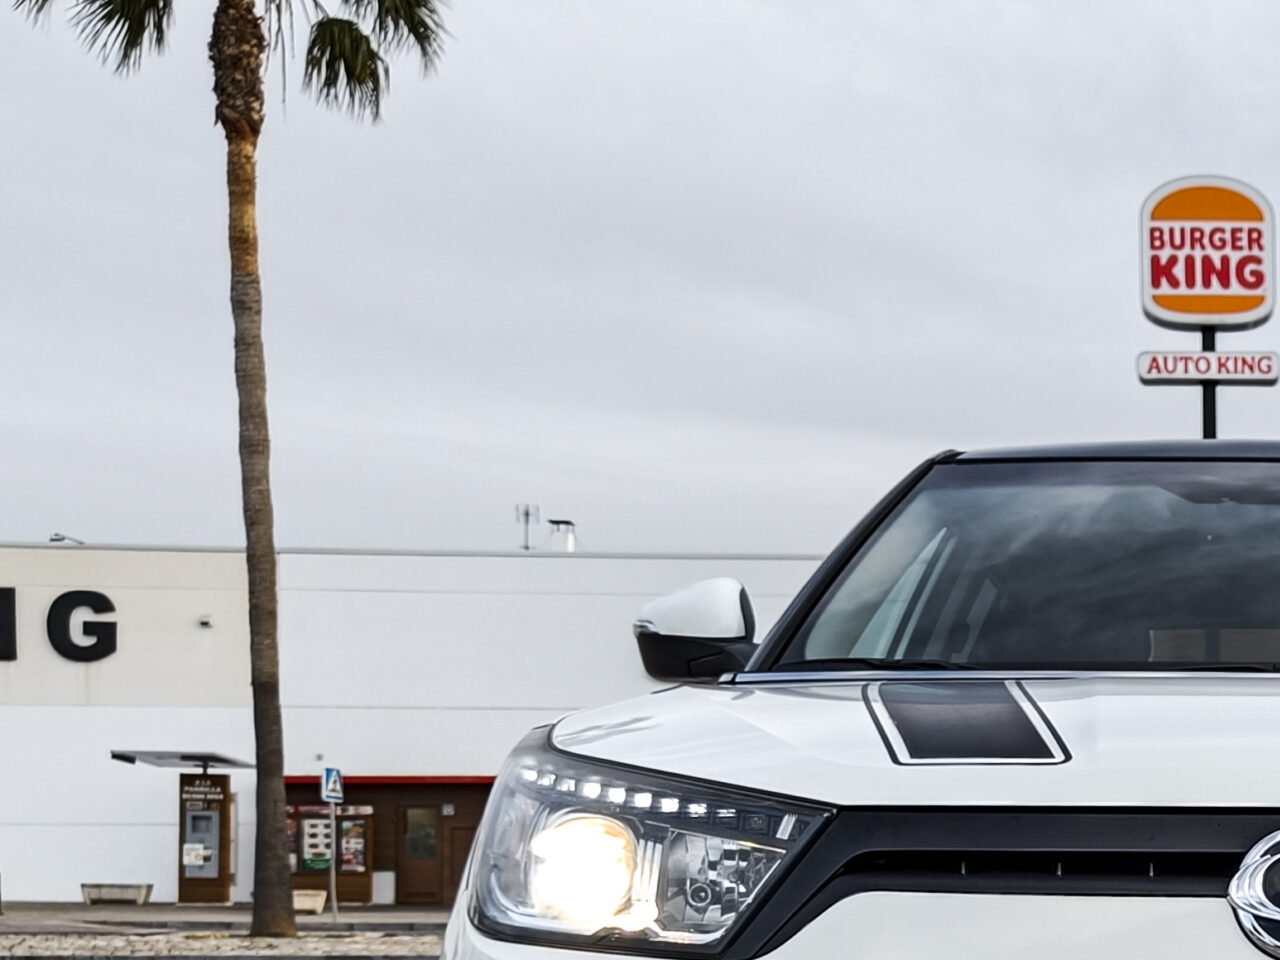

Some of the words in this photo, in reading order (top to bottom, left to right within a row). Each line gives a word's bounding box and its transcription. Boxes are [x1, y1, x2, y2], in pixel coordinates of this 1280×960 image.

[1149, 227, 1264, 251] BURGER
[1150, 254, 1265, 290] KING
[1147, 356, 1211, 374] AUTO
[1217, 356, 1273, 374] KING
